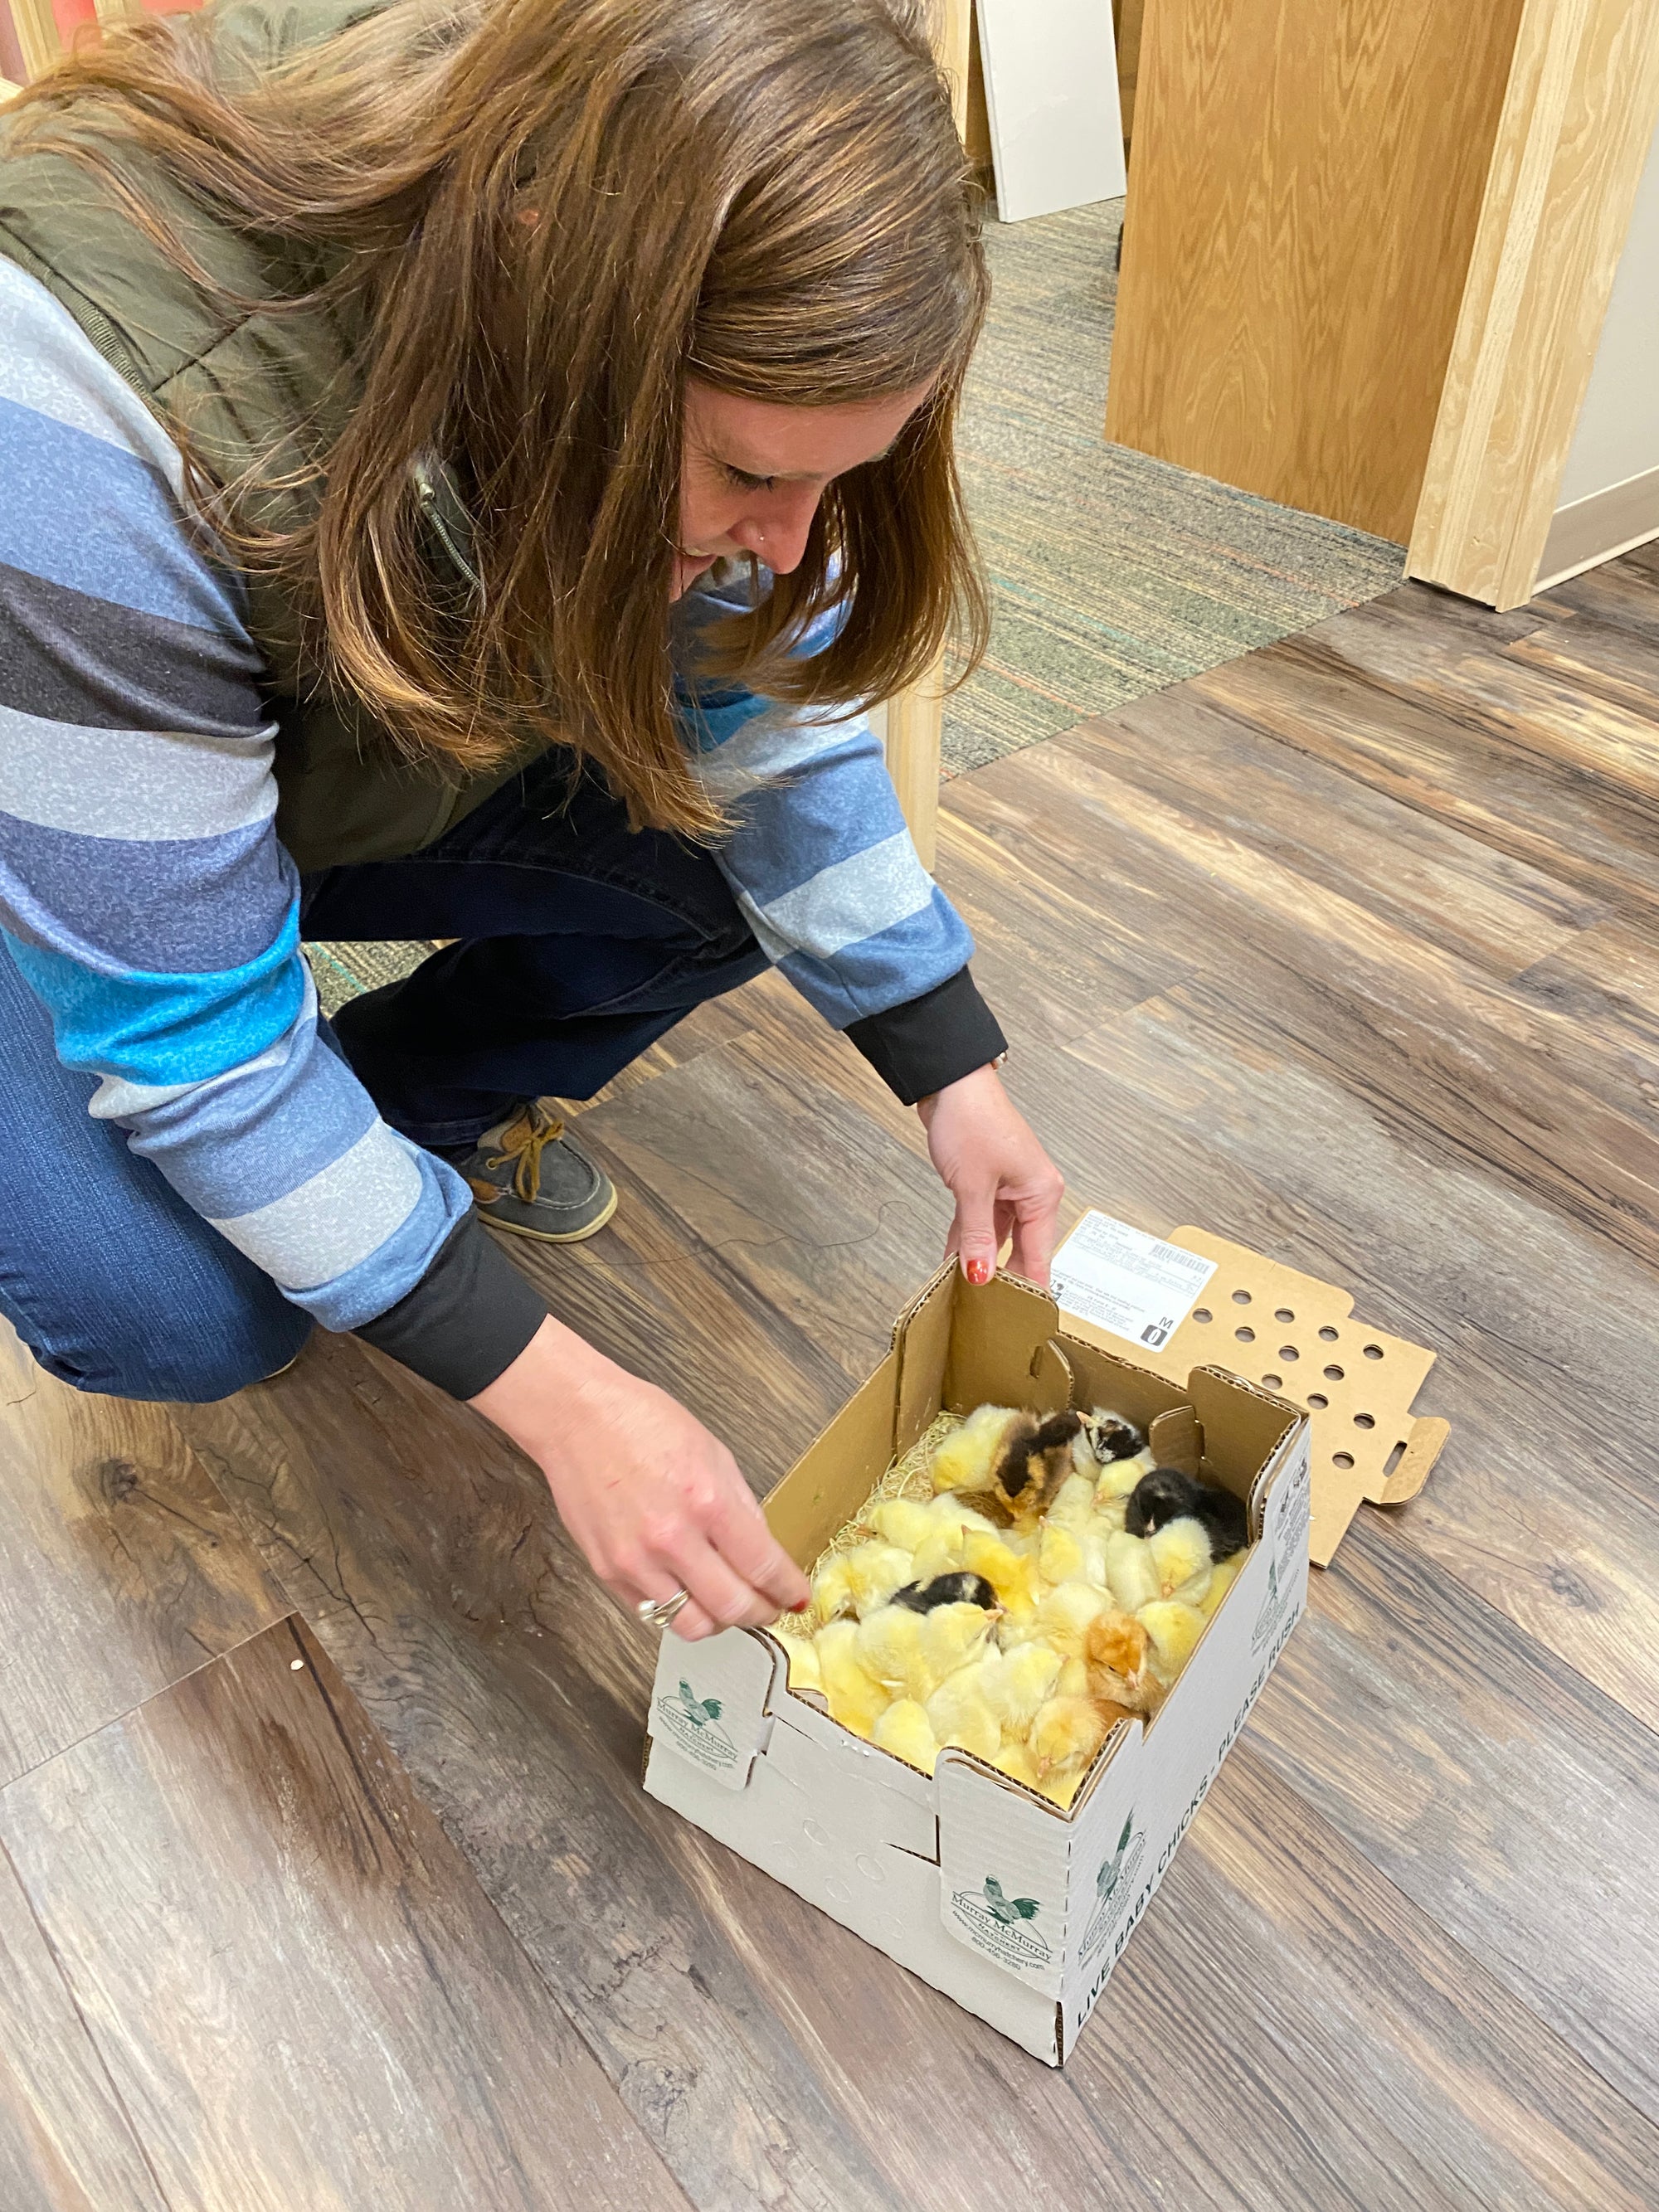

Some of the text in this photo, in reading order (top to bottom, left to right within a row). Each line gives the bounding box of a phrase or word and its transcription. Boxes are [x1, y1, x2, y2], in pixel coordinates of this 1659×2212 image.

[657, 1700, 738, 1760] Murray McMurray
[1078, 1957, 1111, 2028] LIVE
[1115, 1872, 1155, 1957] BABY
[1158, 1774, 1208, 1874] CHICKS
[1219, 1665, 1266, 1762] PLEASE
[1268, 1601, 1299, 1669] RUSH
[952, 1894, 991, 1923] Murray
[995, 1919, 1052, 1962] McMurray
[978, 1923, 1021, 1952] HATCHERY
